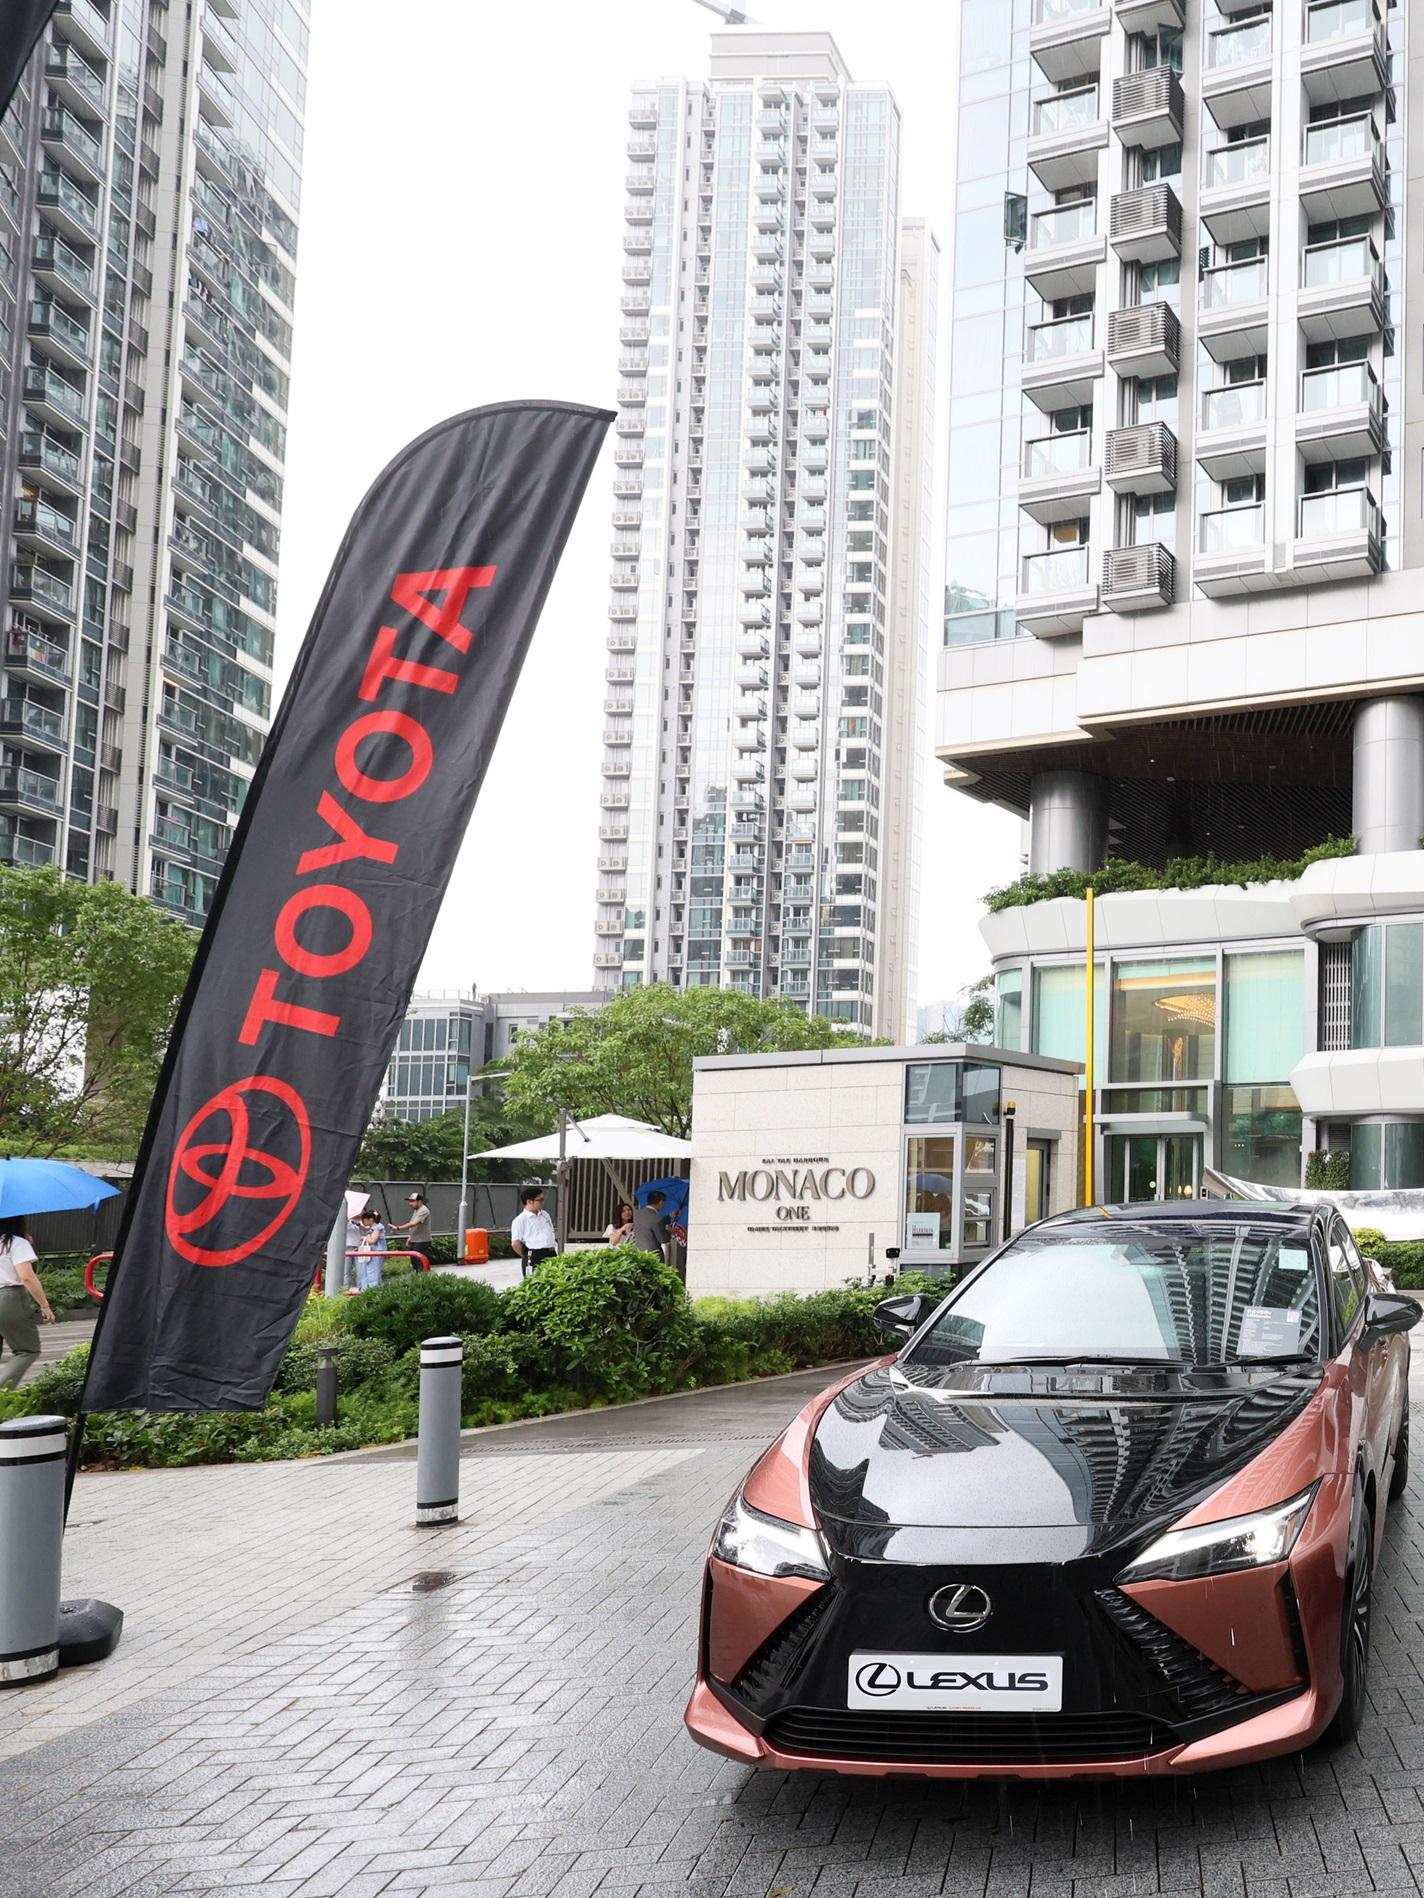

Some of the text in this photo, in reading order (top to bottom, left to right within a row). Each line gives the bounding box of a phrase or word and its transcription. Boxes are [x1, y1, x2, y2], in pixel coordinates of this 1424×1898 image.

[237, 565, 497, 1046] TOYOTA
[717, 1167, 876, 1201] MONACO
[776, 1205, 811, 1221] ONE
[906, 1671, 1049, 1691] LEXUS
